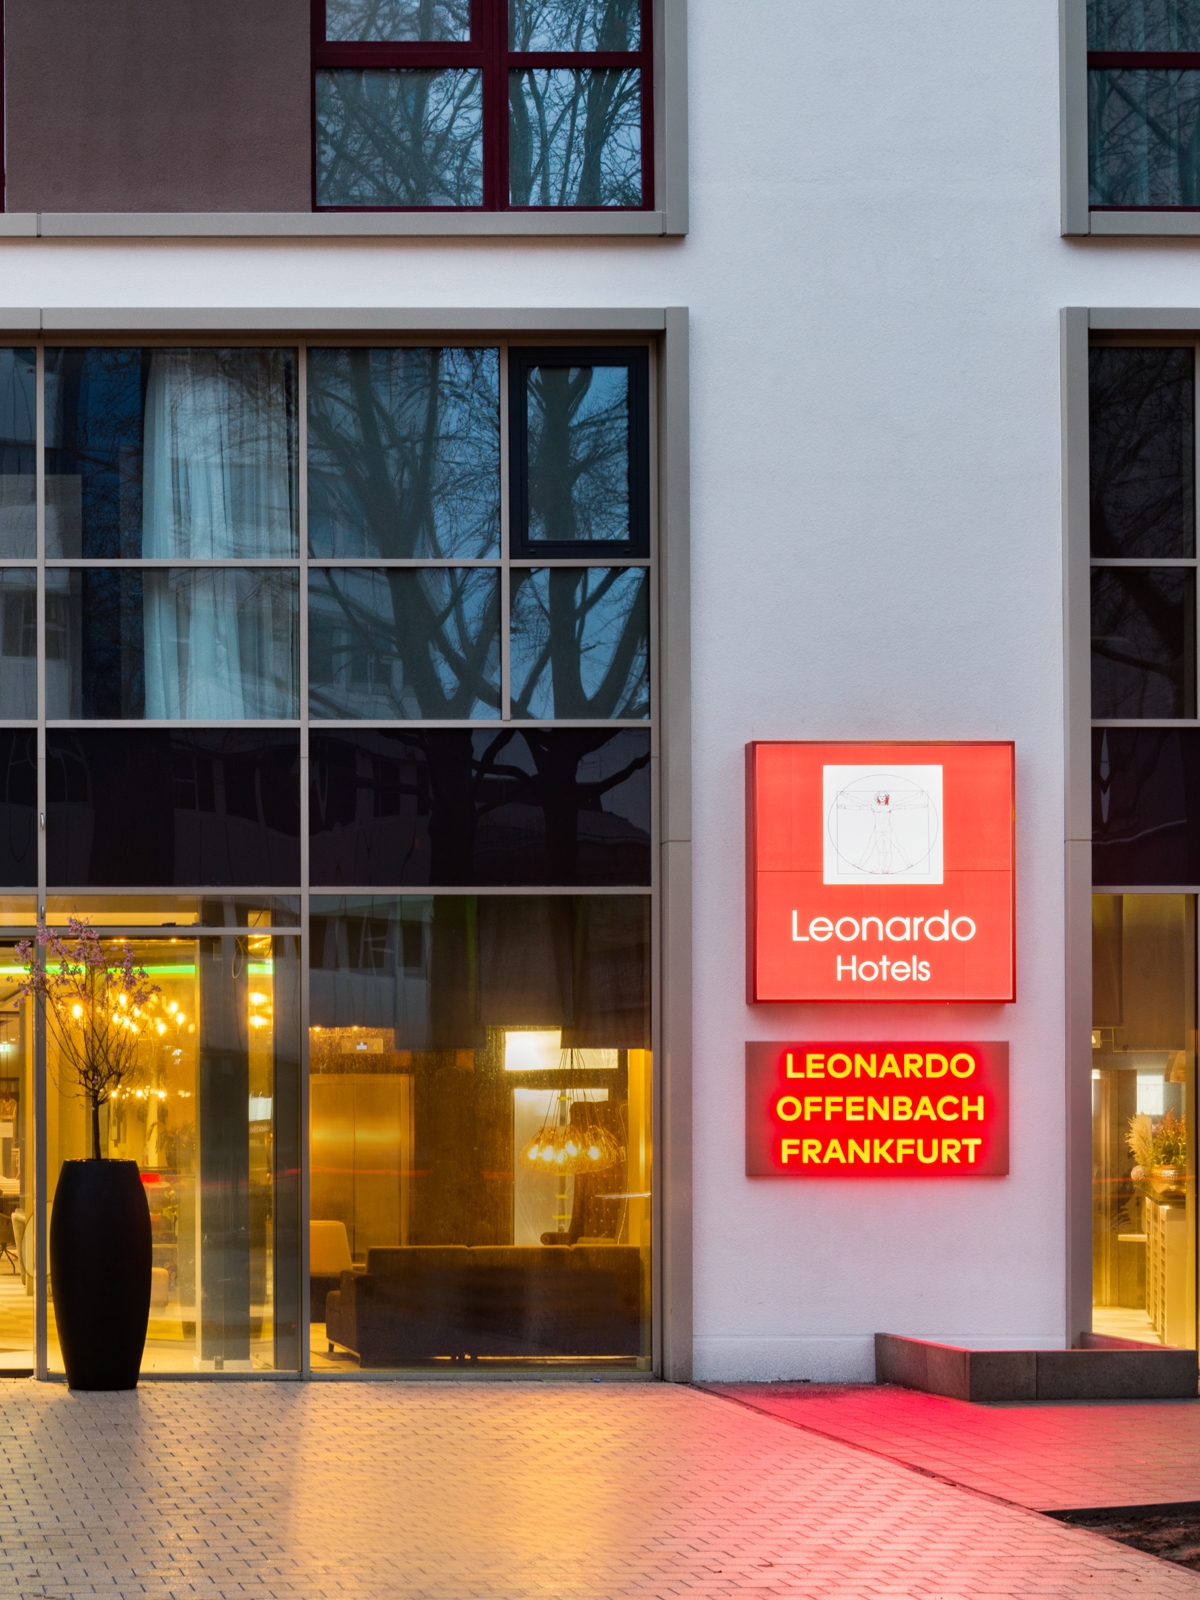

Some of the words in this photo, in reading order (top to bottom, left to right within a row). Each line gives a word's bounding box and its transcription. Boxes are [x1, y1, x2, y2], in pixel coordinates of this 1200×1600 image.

[791, 909, 977, 942] Leonardo
[836, 954, 931, 982] Hotels
[785, 1052, 977, 1079] LEONARDO
[775, 1095, 985, 1122] OFFENBACH
[780, 1138, 982, 1164] FRANKFURT
